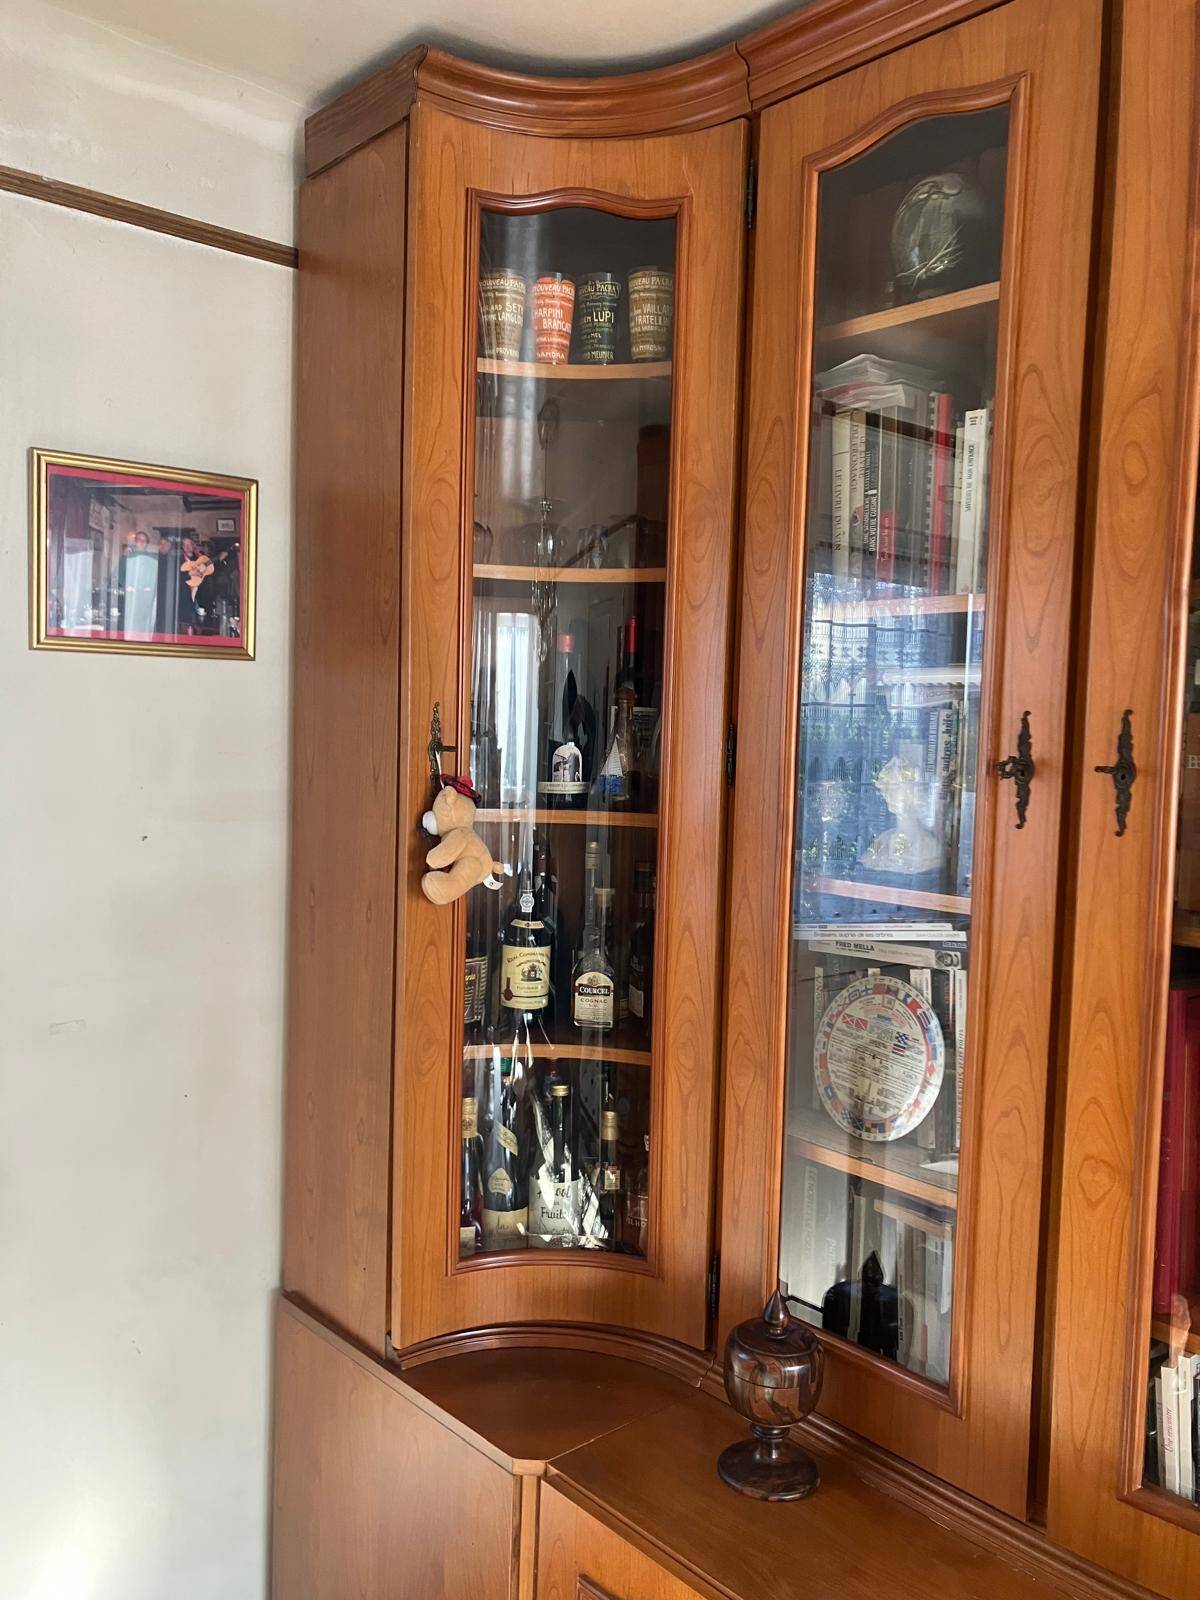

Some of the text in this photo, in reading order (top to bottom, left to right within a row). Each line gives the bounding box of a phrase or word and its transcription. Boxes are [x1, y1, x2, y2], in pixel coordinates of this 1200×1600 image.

[593, 311, 614, 323] LUPI
[854, 943, 875, 951] MELLA
[579, 986, 609, 994] COURCEL
